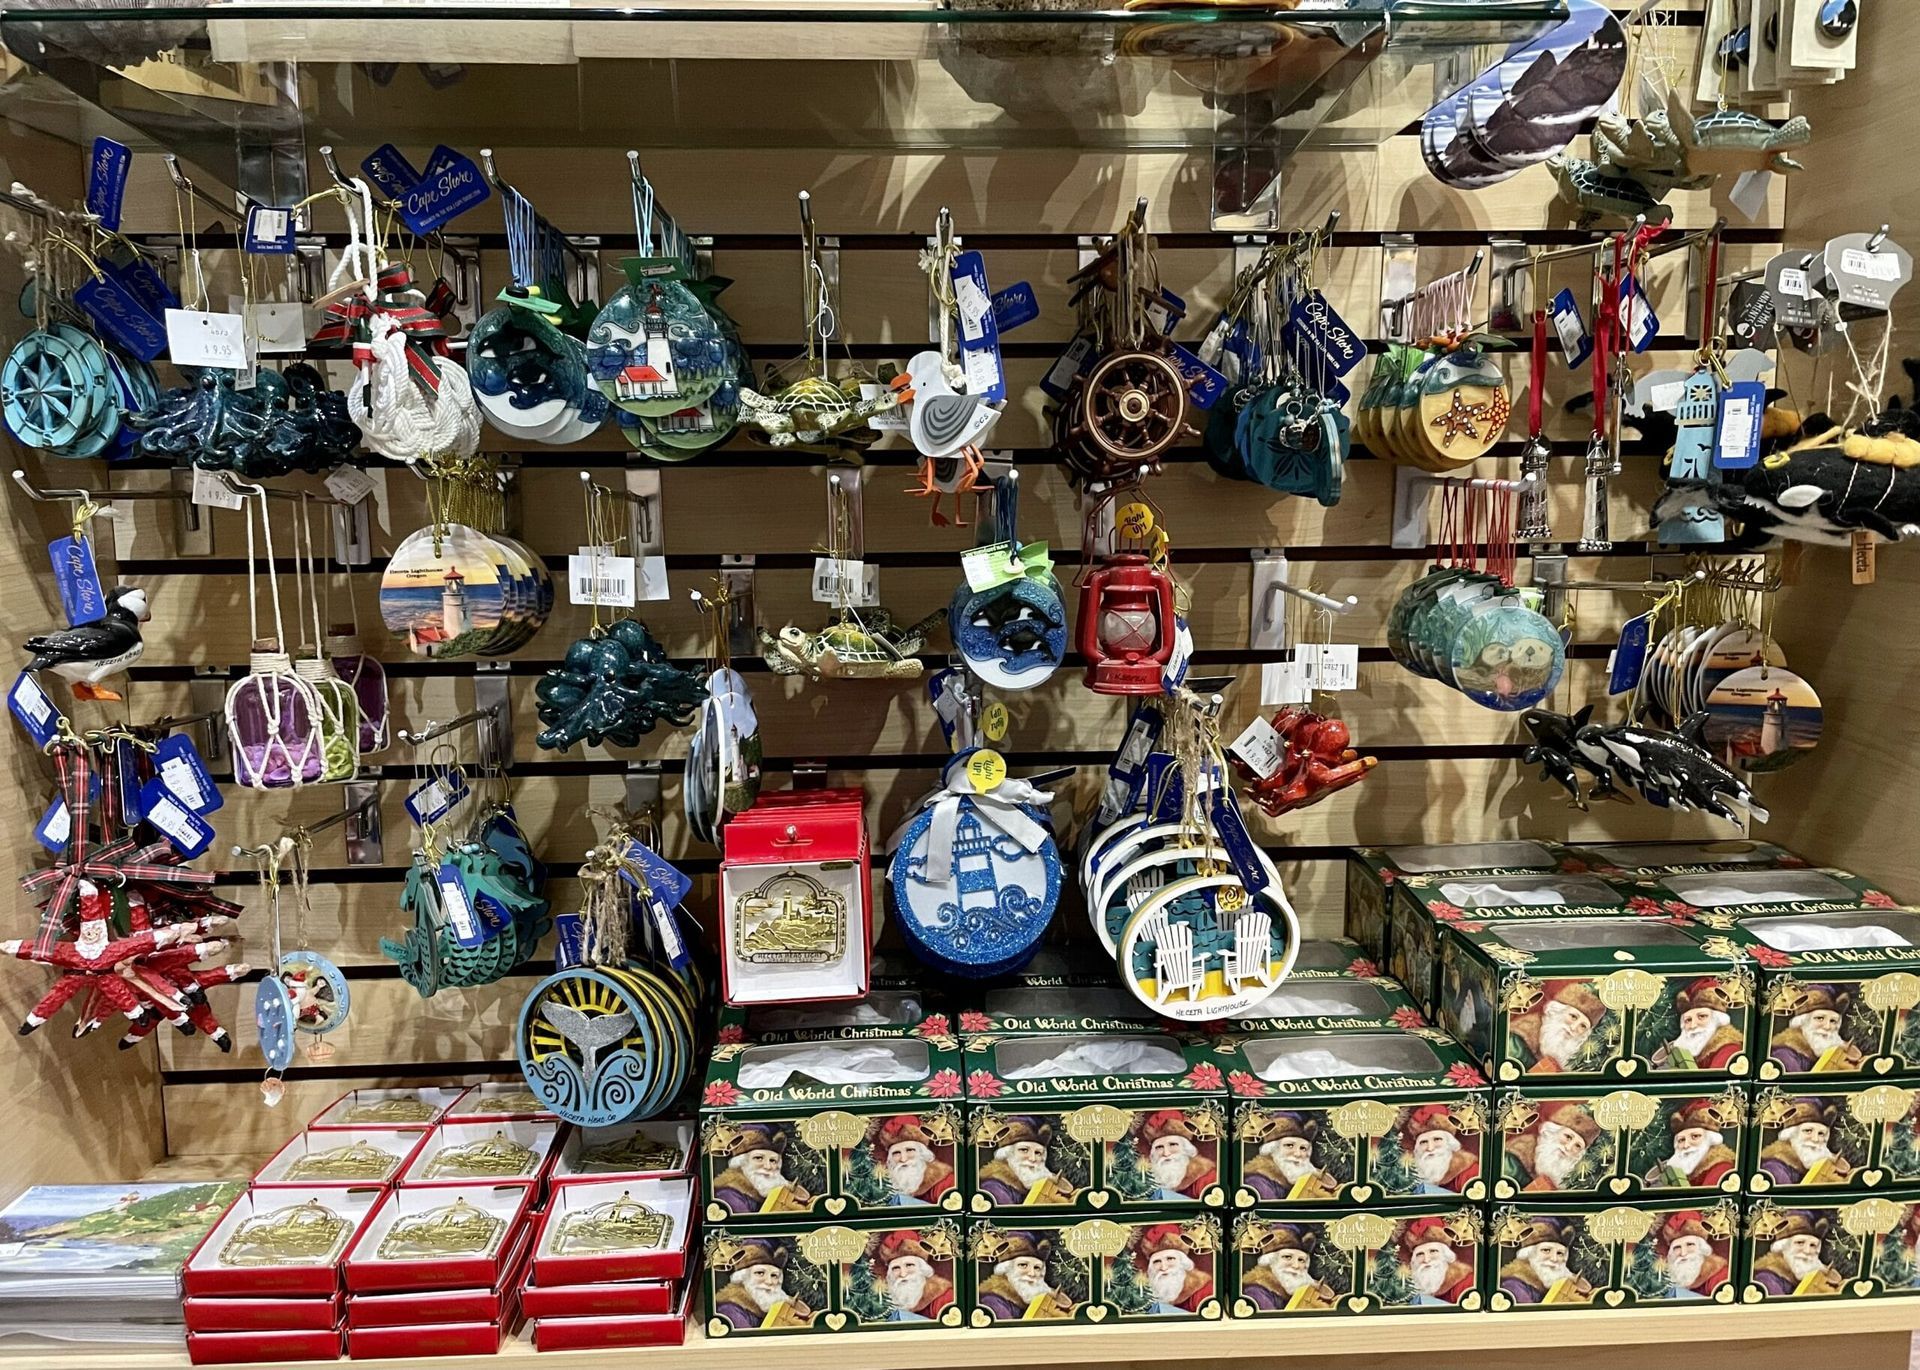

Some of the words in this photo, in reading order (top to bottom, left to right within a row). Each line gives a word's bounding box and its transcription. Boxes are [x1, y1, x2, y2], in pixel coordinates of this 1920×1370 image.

[98, 147, 114, 183] Shore
[408, 190, 439, 214] Cape
[438, 170, 473, 197] Shore
[993, 293, 1027, 315] Shore
[93, 286, 126, 320] Cape
[126, 314, 159, 348] Shore
[1305, 302, 1330, 330] Cape
[1326, 327, 1354, 359] Shore
[66, 545, 85, 577] Cape
[76, 579, 96, 615] Shore
[1222, 814, 1238, 845] Cape
[625, 848, 651, 873] Cape
[650, 867, 680, 894] Shore
[1665, 865, 1708, 875] World
[475, 899, 501, 928] Shore
[1475, 906, 1504, 918] Old
[1505, 906, 1552, 917] World
[1552, 904, 1618, 917] Christmas
[1713, 906, 1743, 916] Old
[1743, 904, 1789, 915] World
[1790, 901, 1856, 913] Christmas
[1801, 951, 1835, 964] Old
[1835, 949, 1886, 962] World
[1026, 976, 1063, 986] World
[1606, 978, 1623, 991] Old
[1623, 977, 1653, 991] World
[1872, 983, 1889, 995] Old
[1889, 981, 1918, 994] World
[1605, 989, 1656, 1003] Christmas
[1868, 991, 1919, 1005] Christmas
[1176, 1008, 1203, 1017] HECETA
[1206, 999, 1251, 1015] LIGHTHOUSE
[1003, 1018, 1031, 1031] Old
[1034, 1017, 1077, 1031] World
[1081, 1017, 1144, 1031] Christmas
[1240, 1019, 1269, 1032] Old
[1269, 1018, 1315, 1030] World
[1317, 1016, 1382, 1030] Christmas
[762, 1031, 788, 1043] Old
[794, 1029, 835, 1043] World
[840, 1026, 905, 1041] Christmas
[1016, 1080, 1048, 1095] Old
[1050, 1078, 1099, 1093] World
[1102, 1075, 1174, 1091] Christmas
[1279, 1080, 1312, 1094] Old
[1312, 1078, 1360, 1092] World
[1364, 1075, 1436, 1090] Christmas
[752, 1088, 784, 1102] Old
[788, 1086, 836, 1101] World
[840, 1084, 913, 1100] Christmas
[1600, 1100, 1618, 1113] Old
[1618, 1099, 1647, 1112] World
[1859, 1096, 1876, 1108] Old
[1876, 1094, 1904, 1107] World
[559, 1110, 585, 1122] HECETA
[1339, 1110, 1357, 1121] Old
[1357, 1108, 1387, 1120] World
[1600, 1111, 1651, 1124] Christmas
[1856, 1103, 1910, 1118] Christmas
[808, 1120, 827, 1132] Old
[826, 1119, 857, 1132] World
[1073, 1114, 1092, 1126] Old
[1092, 1113, 1121, 1125] World
[1338, 1120, 1390, 1133] Christmas
[806, 1130, 860, 1144] Christmas
[1071, 1124, 1125, 1137] Christmas
[1597, 1215, 1614, 1227] Old
[1614, 1213, 1642, 1226] World
[1845, 1208, 1866, 1221] Old
[1866, 1206, 1895, 1219] World
[1337, 1223, 1355, 1234] Old
[1355, 1221, 1384, 1233] World
[1843, 1216, 1898, 1231] Christmas
[1071, 1229, 1090, 1241] Old
[1090, 1228, 1119, 1240] World
[1595, 1224, 1646, 1238] Christmas
[809, 1236, 827, 1247] Old
[826, 1234, 857, 1246] World
[1069, 1239, 1123, 1252] Christmas
[1335, 1232, 1387, 1246] Christmas
[807, 1245, 861, 1259] Christmas
